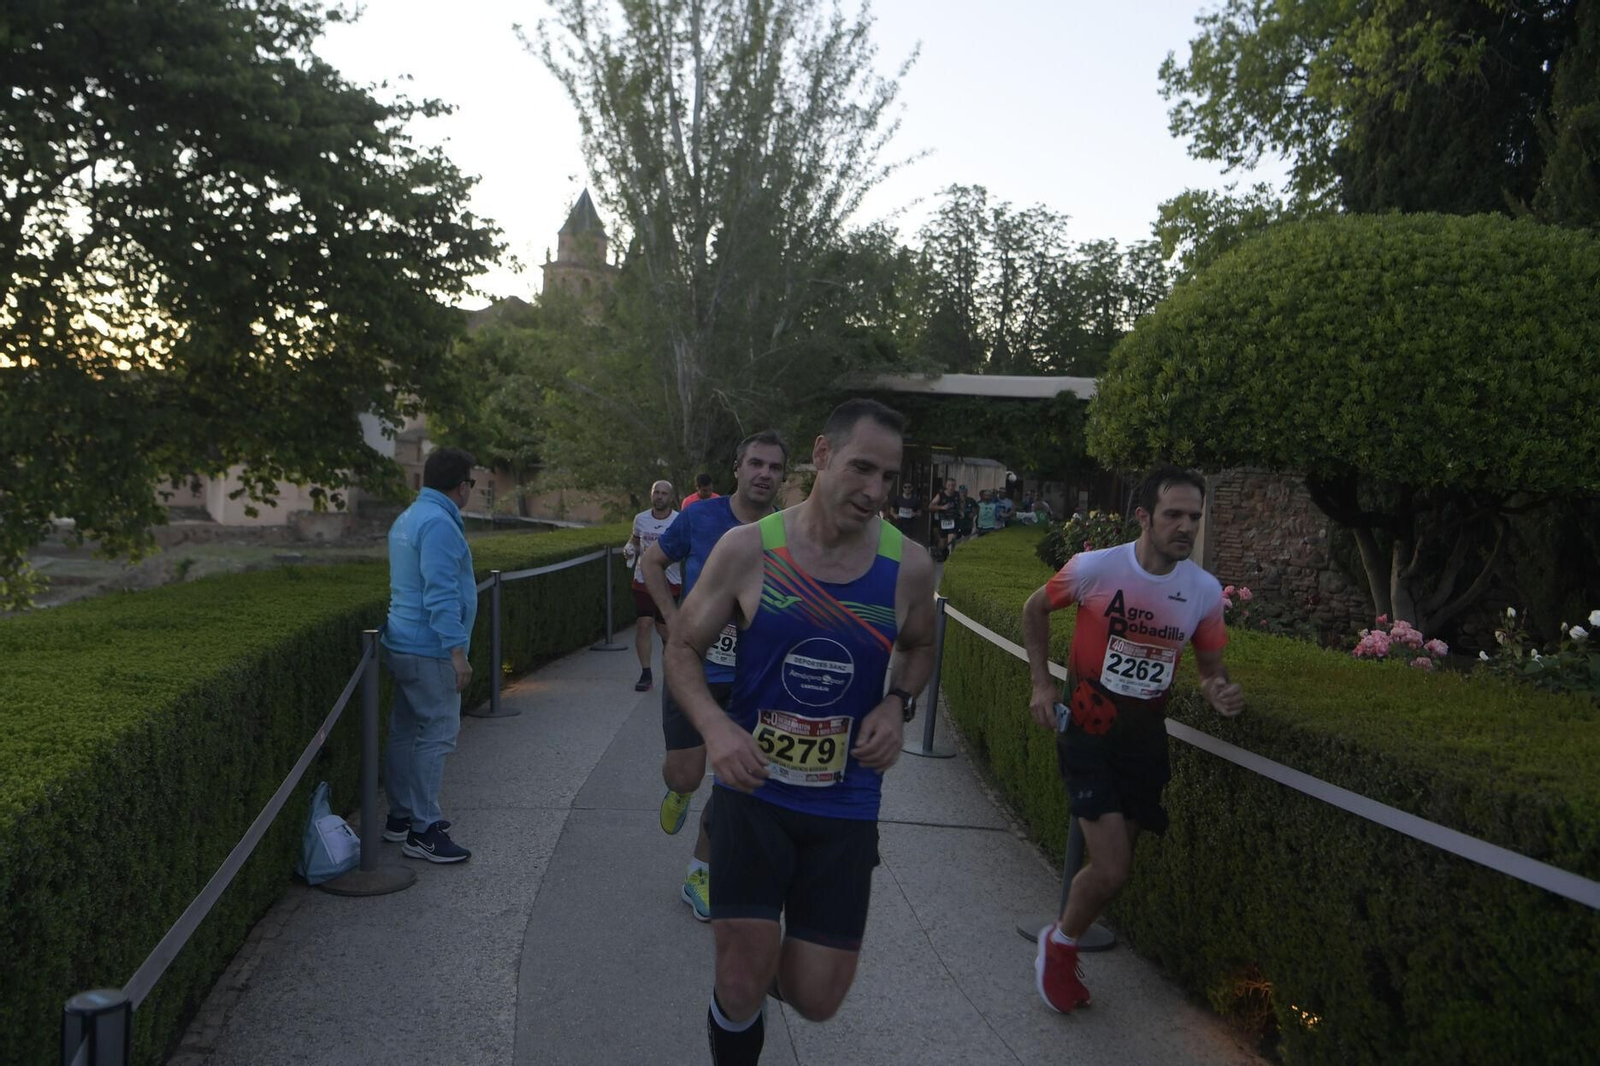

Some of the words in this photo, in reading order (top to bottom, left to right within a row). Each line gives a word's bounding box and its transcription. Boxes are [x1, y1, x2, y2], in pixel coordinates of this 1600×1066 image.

[1103, 589, 1154, 621] Agro
[1108, 615, 1185, 642] Bobadilla
[1111, 641, 1125, 653] 40
[793, 656, 828, 669] DEPORTES
[1106, 653, 1165, 684] 2262
[757, 726, 837, 766] 5279
